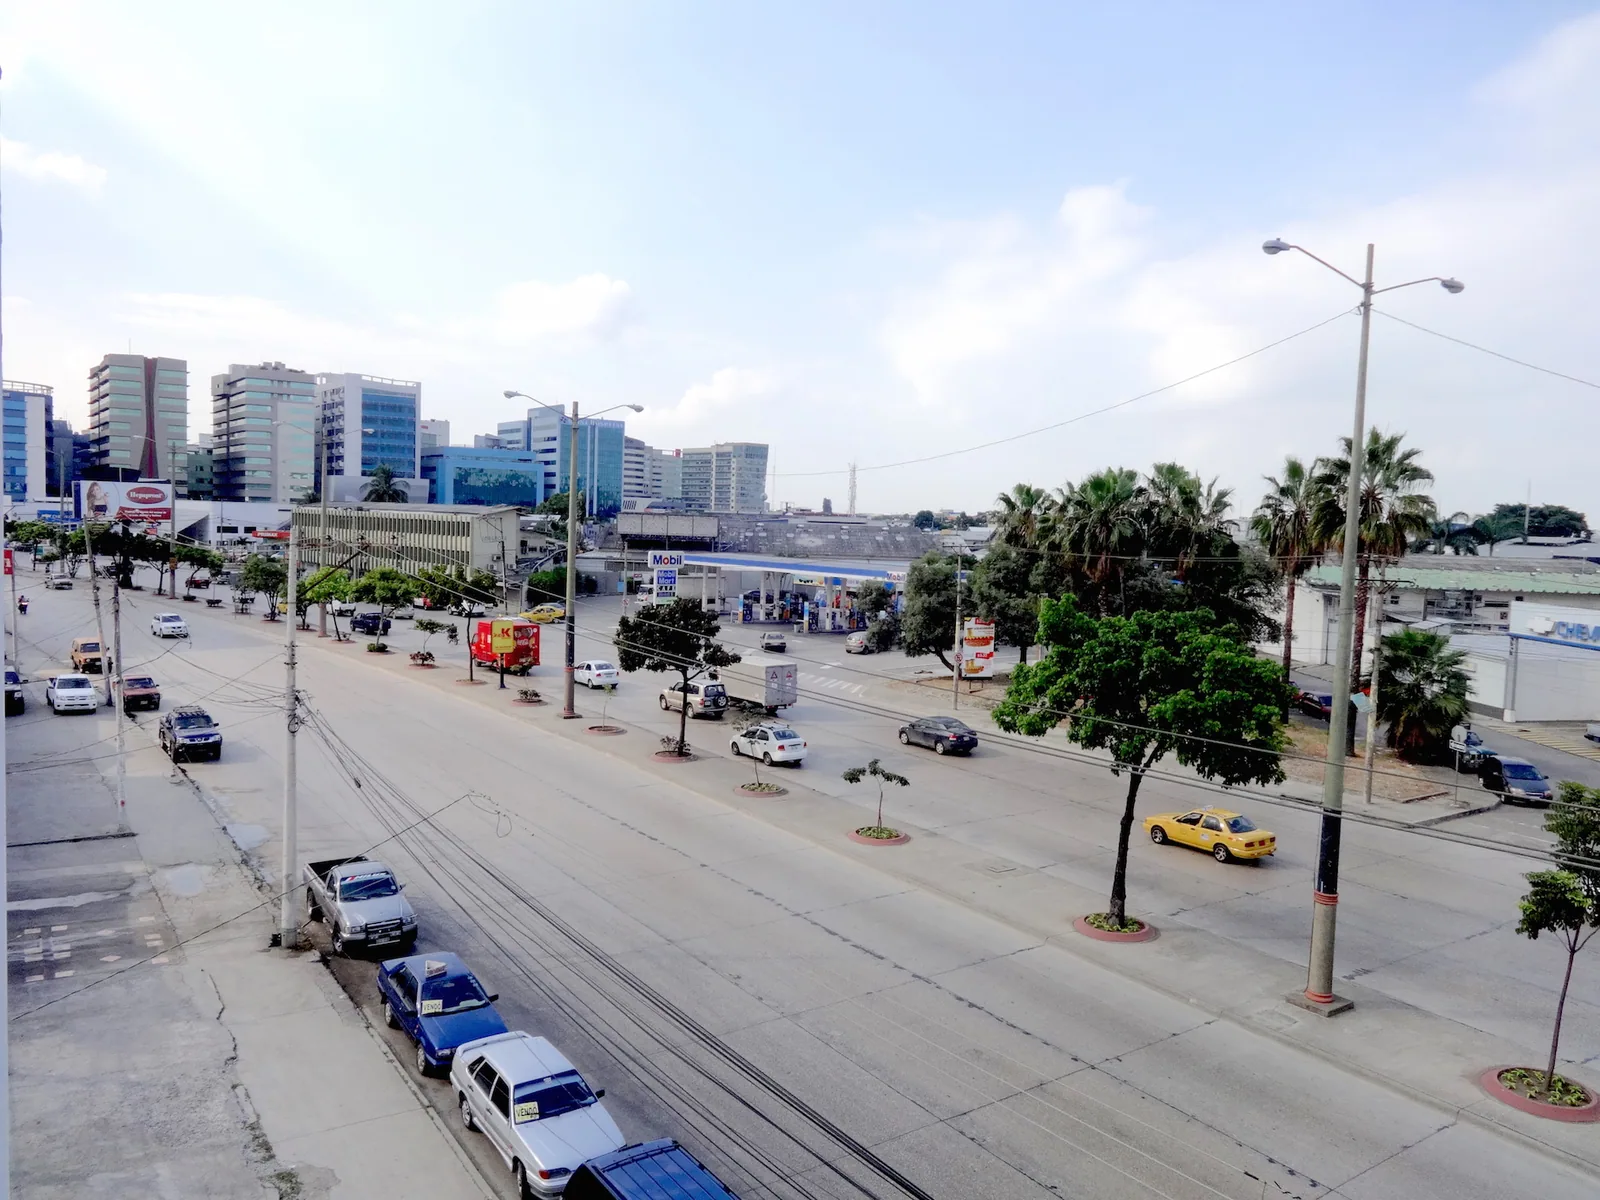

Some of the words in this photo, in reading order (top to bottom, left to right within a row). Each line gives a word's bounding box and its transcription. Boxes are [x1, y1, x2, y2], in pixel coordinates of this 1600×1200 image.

[653, 554, 682, 565] Mobil
[886, 572, 906, 581] Mobil
[423, 1001, 441, 1011] VENDO
[515, 1106, 538, 1117] VENDO
